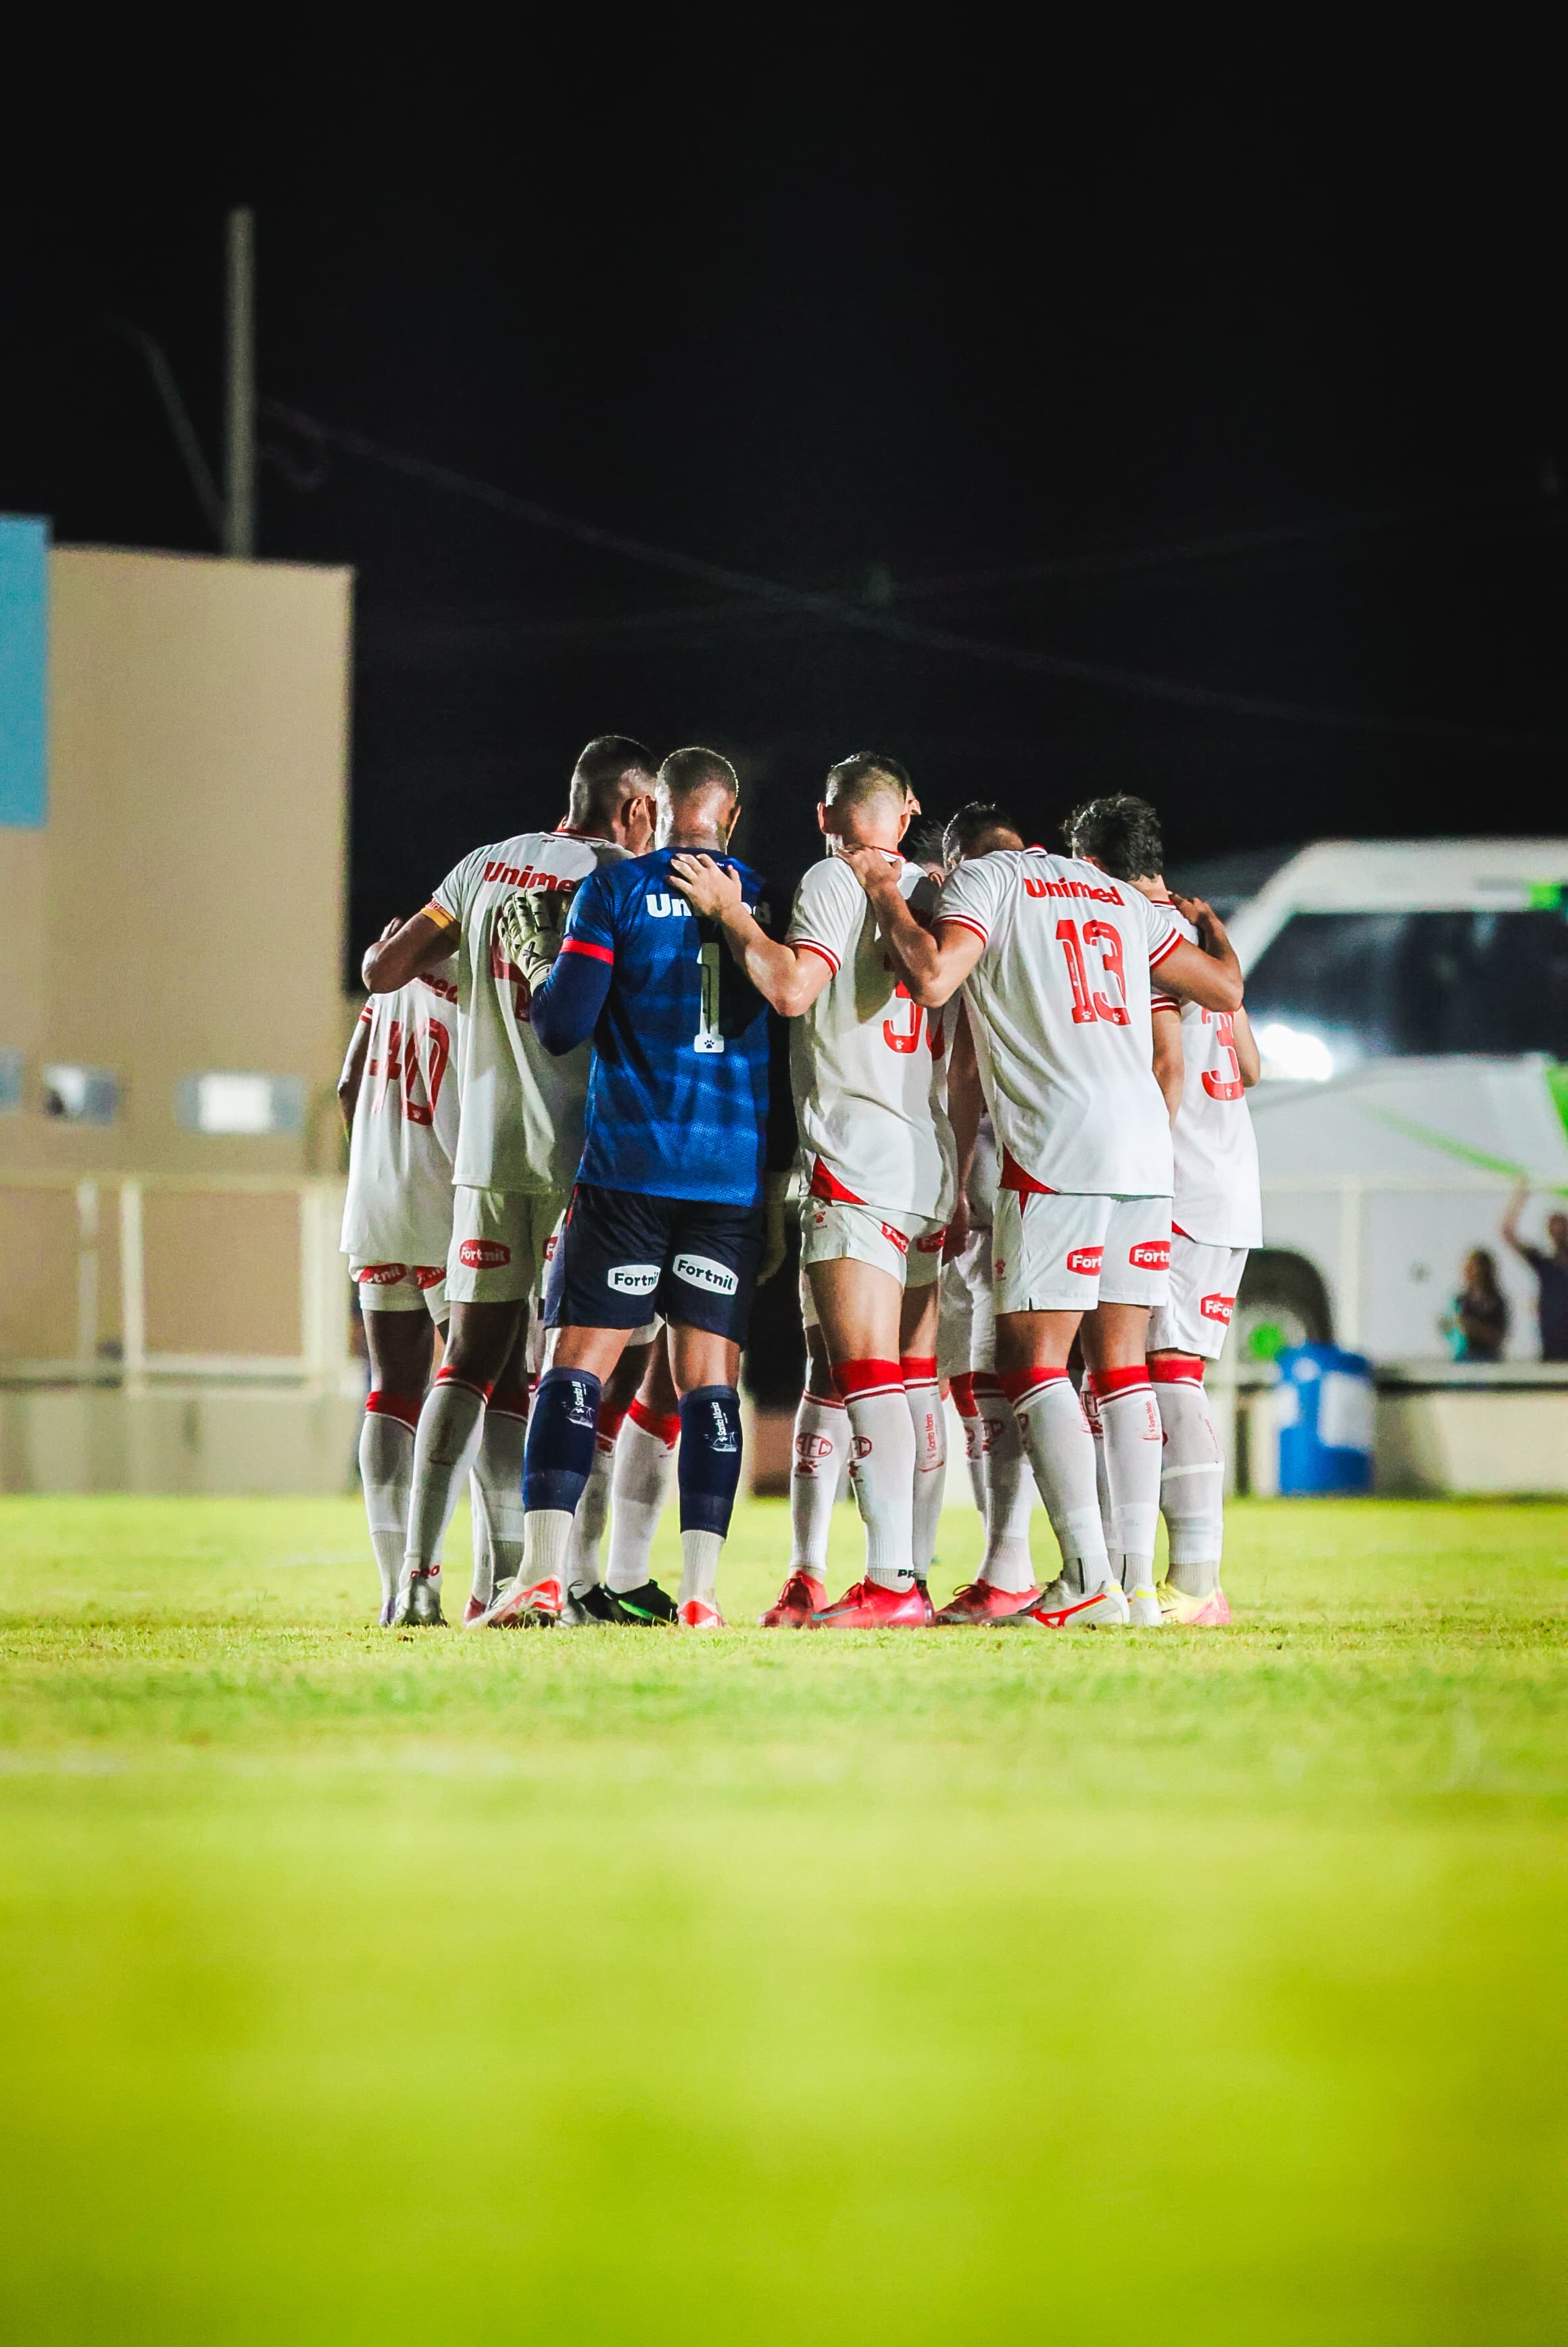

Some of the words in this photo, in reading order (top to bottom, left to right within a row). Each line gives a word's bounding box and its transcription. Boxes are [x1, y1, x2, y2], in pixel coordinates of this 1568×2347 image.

[484, 861, 576, 892] Unime
[1023, 877, 1125, 906] Unimed
[1056, 919, 1131, 1025] 13
[694, 942, 725, 1052] 1
[677, 1259, 733, 1290] Fortnil
